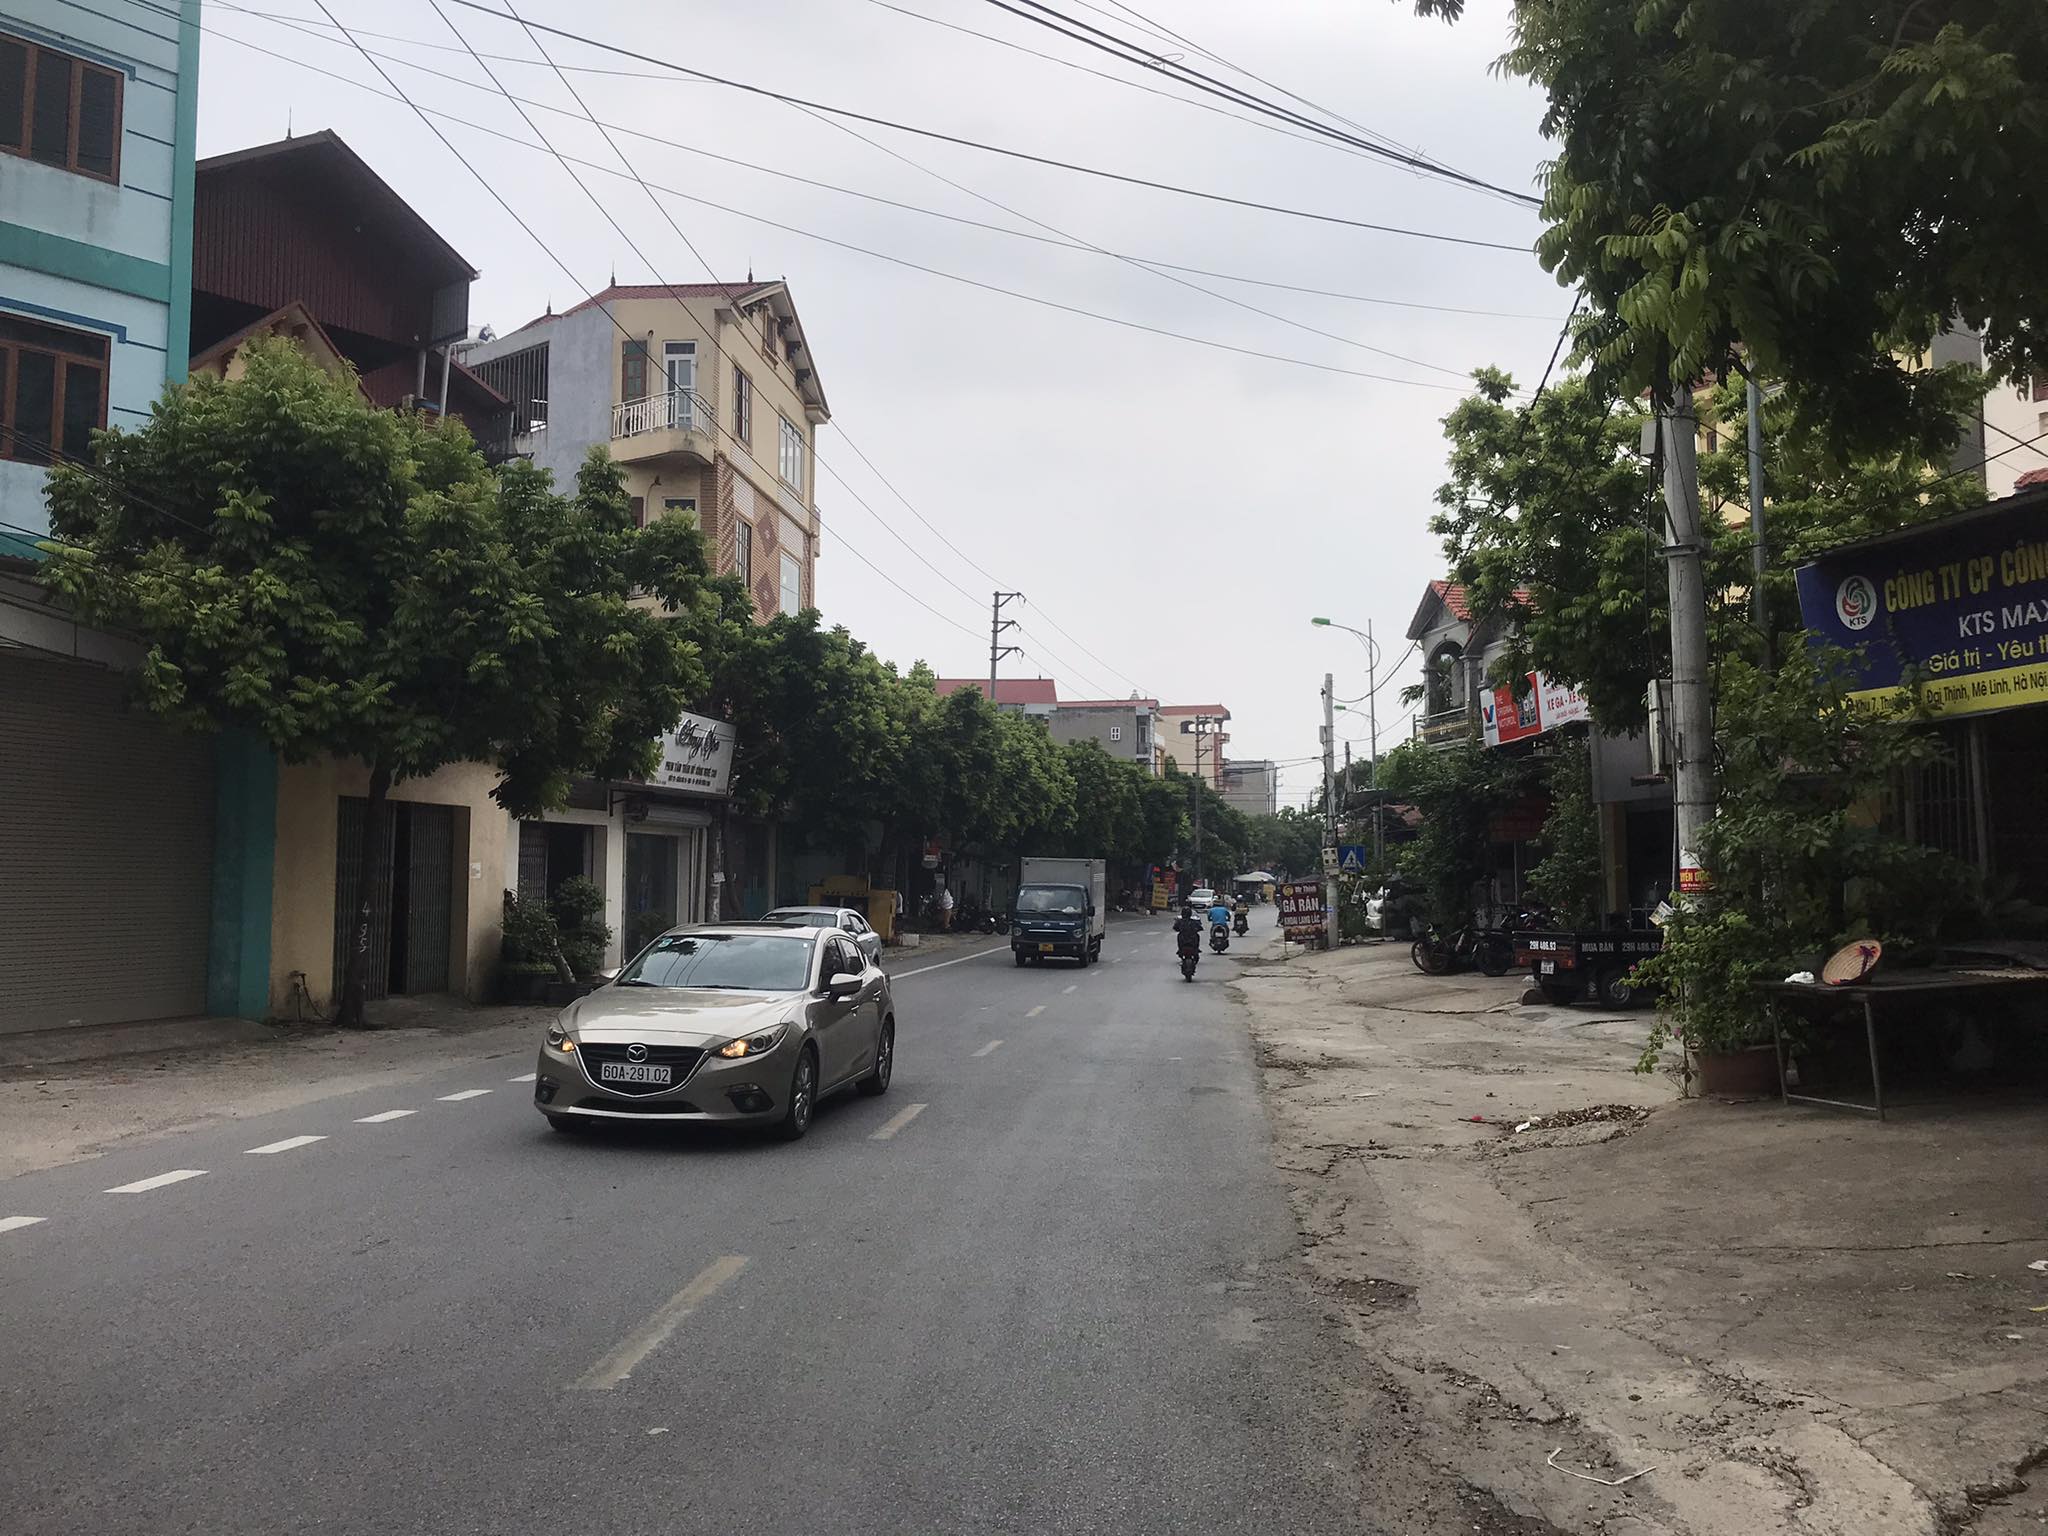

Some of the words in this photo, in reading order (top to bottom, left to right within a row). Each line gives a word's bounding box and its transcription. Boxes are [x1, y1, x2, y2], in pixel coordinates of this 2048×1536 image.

[1884, 568, 1936, 613] CÔNG
[1939, 563, 1961, 600] TY
[1967, 556, 1994, 595] CP
[1849, 615, 1867, 626] KTS
[1958, 610, 1995, 638] KTS
[1928, 650, 1959, 673] Giá
[1963, 647, 1981, 669] trị
[1997, 639, 2034, 661] Yêu
[1943, 686, 1970, 705] Thịnh,
[1971, 680, 1987, 698] Mê
[1989, 677, 2011, 696] Linh,
[2013, 673, 2028, 692] Hà
[1283, 896, 1296, 913] GÀ
[1298, 895, 1319, 912] RÁN
[603, 1065, 669, 1082] 60A-291.02
